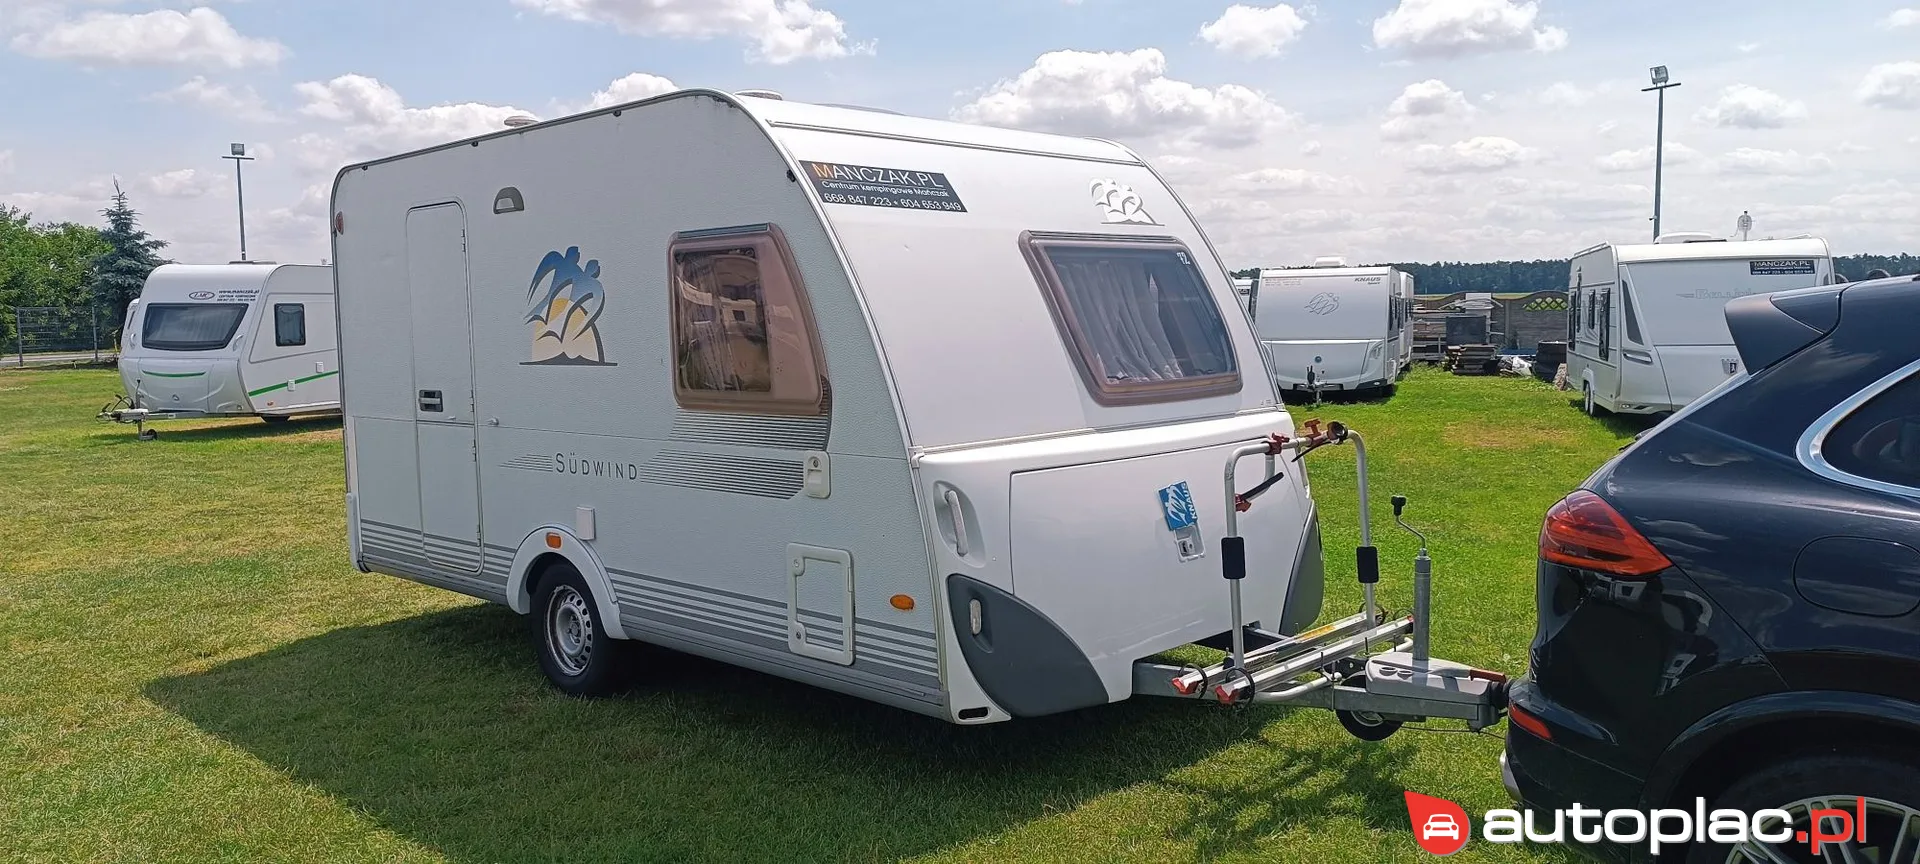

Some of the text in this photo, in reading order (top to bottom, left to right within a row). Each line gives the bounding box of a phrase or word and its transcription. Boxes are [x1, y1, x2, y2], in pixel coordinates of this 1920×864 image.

[811, 162, 944, 188] MANCZAK.PL
[821, 180, 860, 191] Centrum
[861, 184, 914, 195] kempingowe
[824, 192, 962, 212] 668 847 223 604 653 949
[555, 451, 638, 481] SÜDWIND
[1181, 482, 1198, 520] KNAUS
